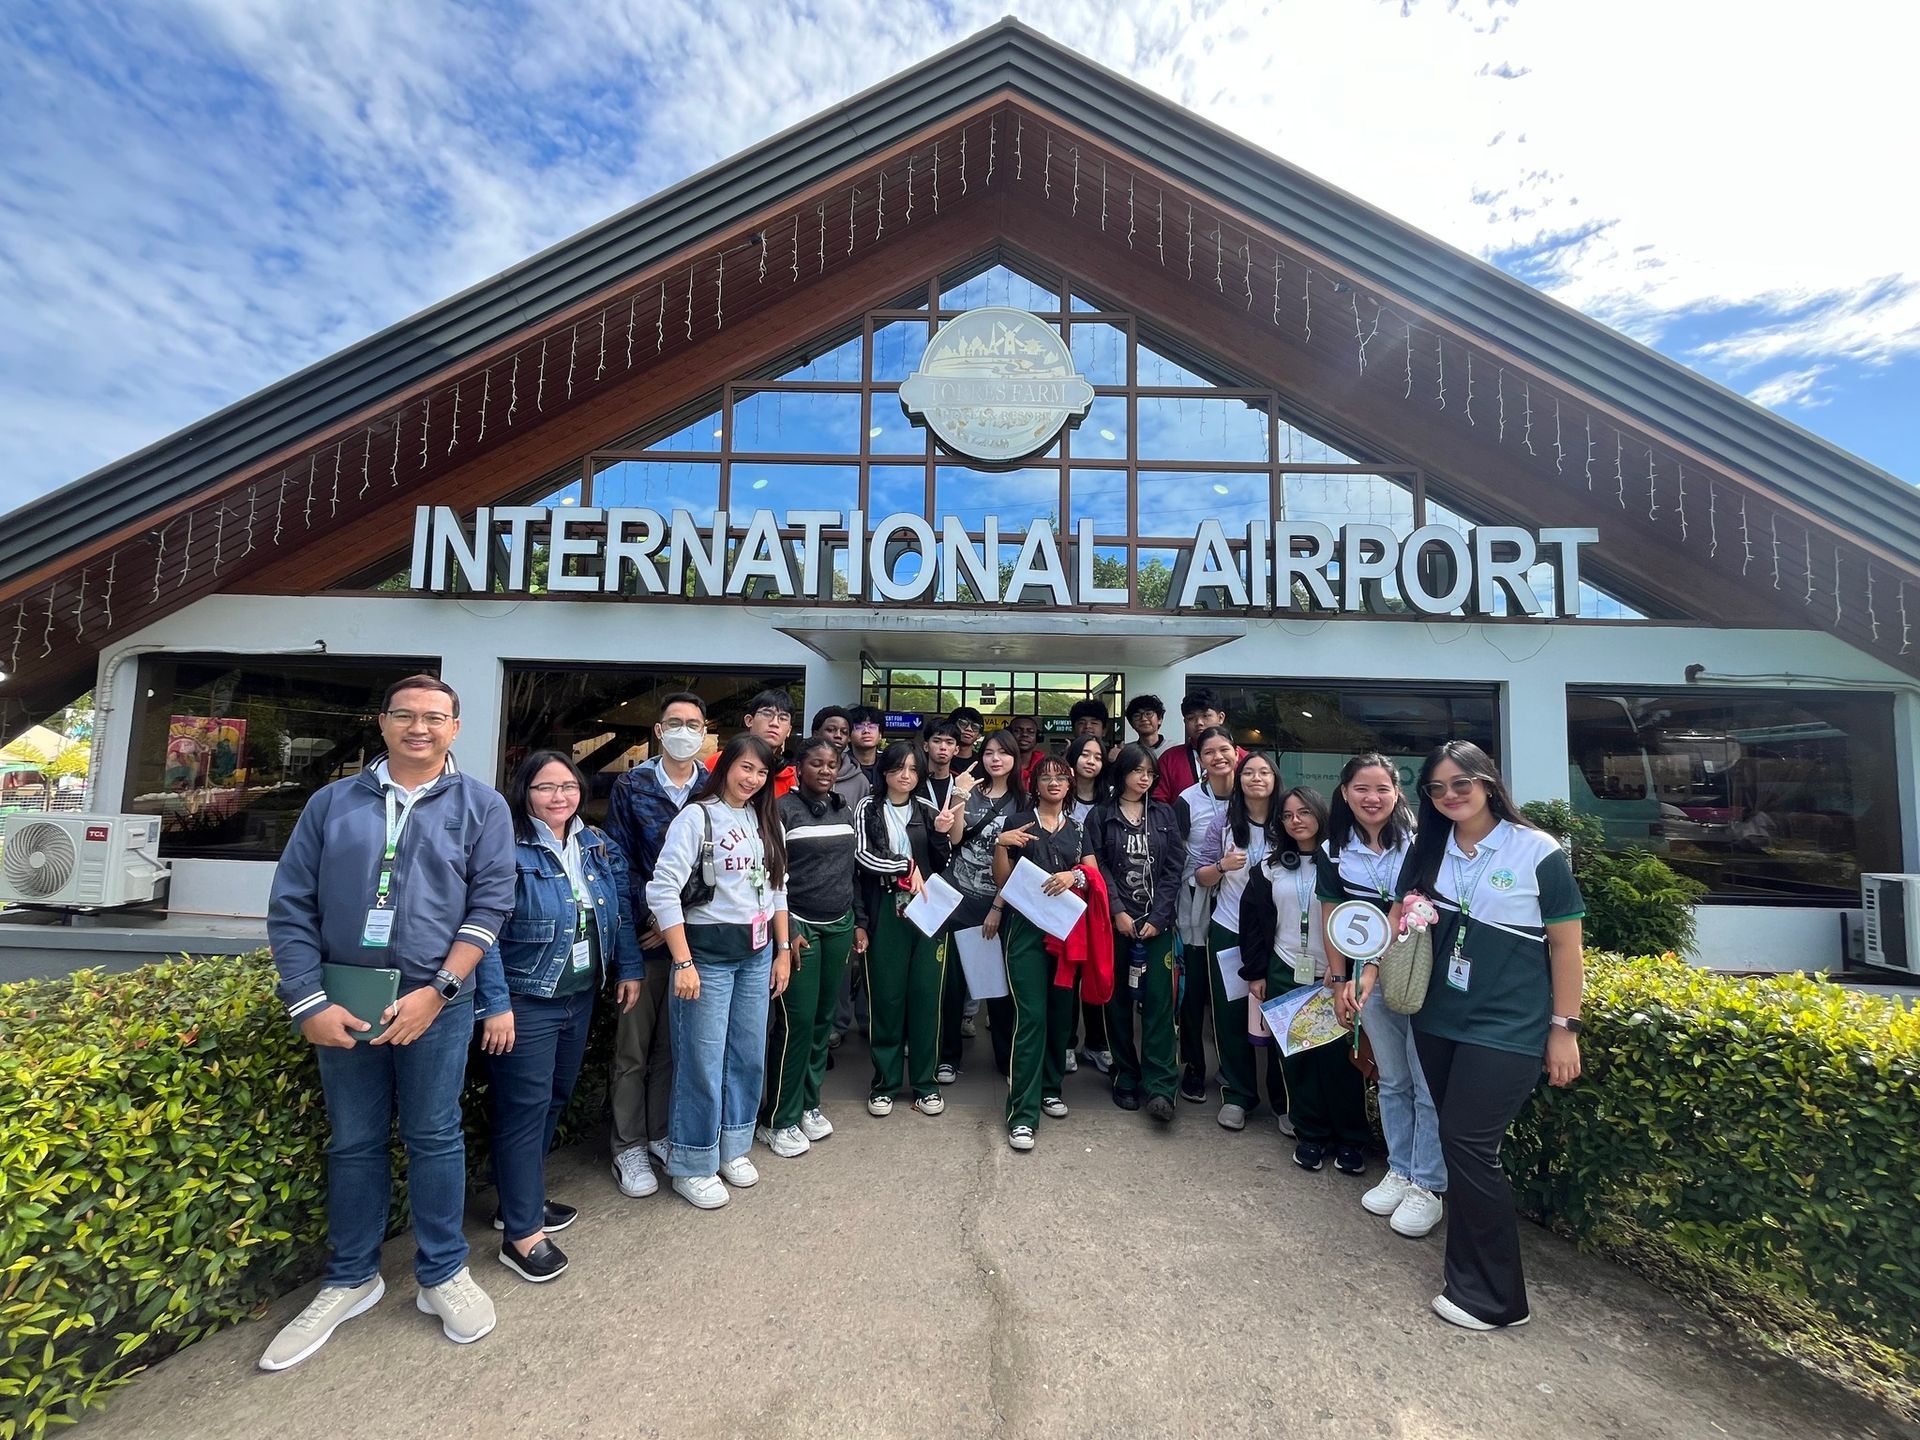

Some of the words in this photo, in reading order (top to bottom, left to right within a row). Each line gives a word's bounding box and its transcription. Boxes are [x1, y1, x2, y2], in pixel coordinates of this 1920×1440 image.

[1011, 383, 1066, 403] FARM
[410, 505, 1129, 606] INTERNATIONAL
[1179, 518, 1600, 618] AIRPORT
[89, 830, 105, 838] TCL
[1346, 914, 1371, 946] 5
